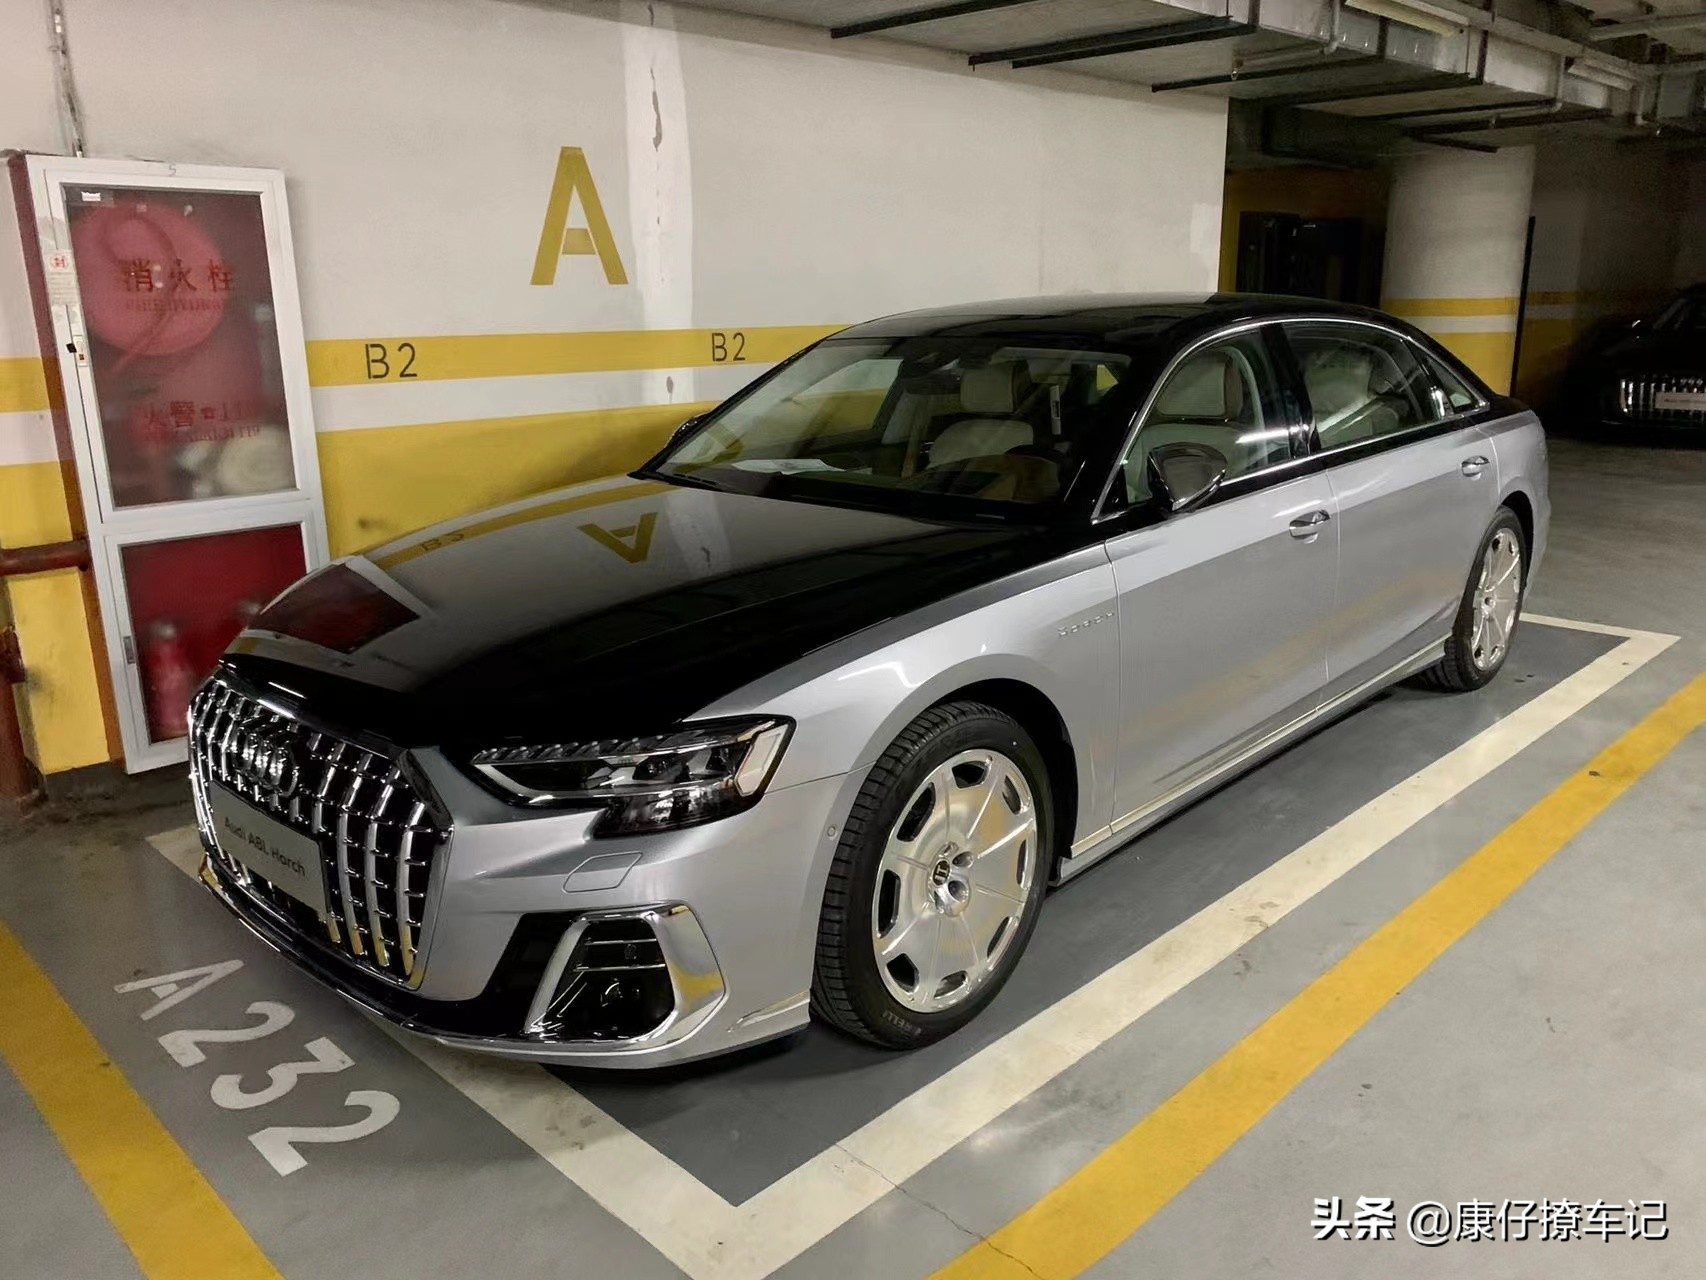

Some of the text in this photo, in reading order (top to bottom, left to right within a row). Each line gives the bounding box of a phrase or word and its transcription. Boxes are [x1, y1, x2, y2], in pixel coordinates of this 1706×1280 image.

[530, 146, 628, 285] A
[364, 342, 418, 379] B2
[711, 331, 746, 362] B2
[224, 816, 306, 877] Audi A8L Horch
[113, 959, 400, 1177] A232
